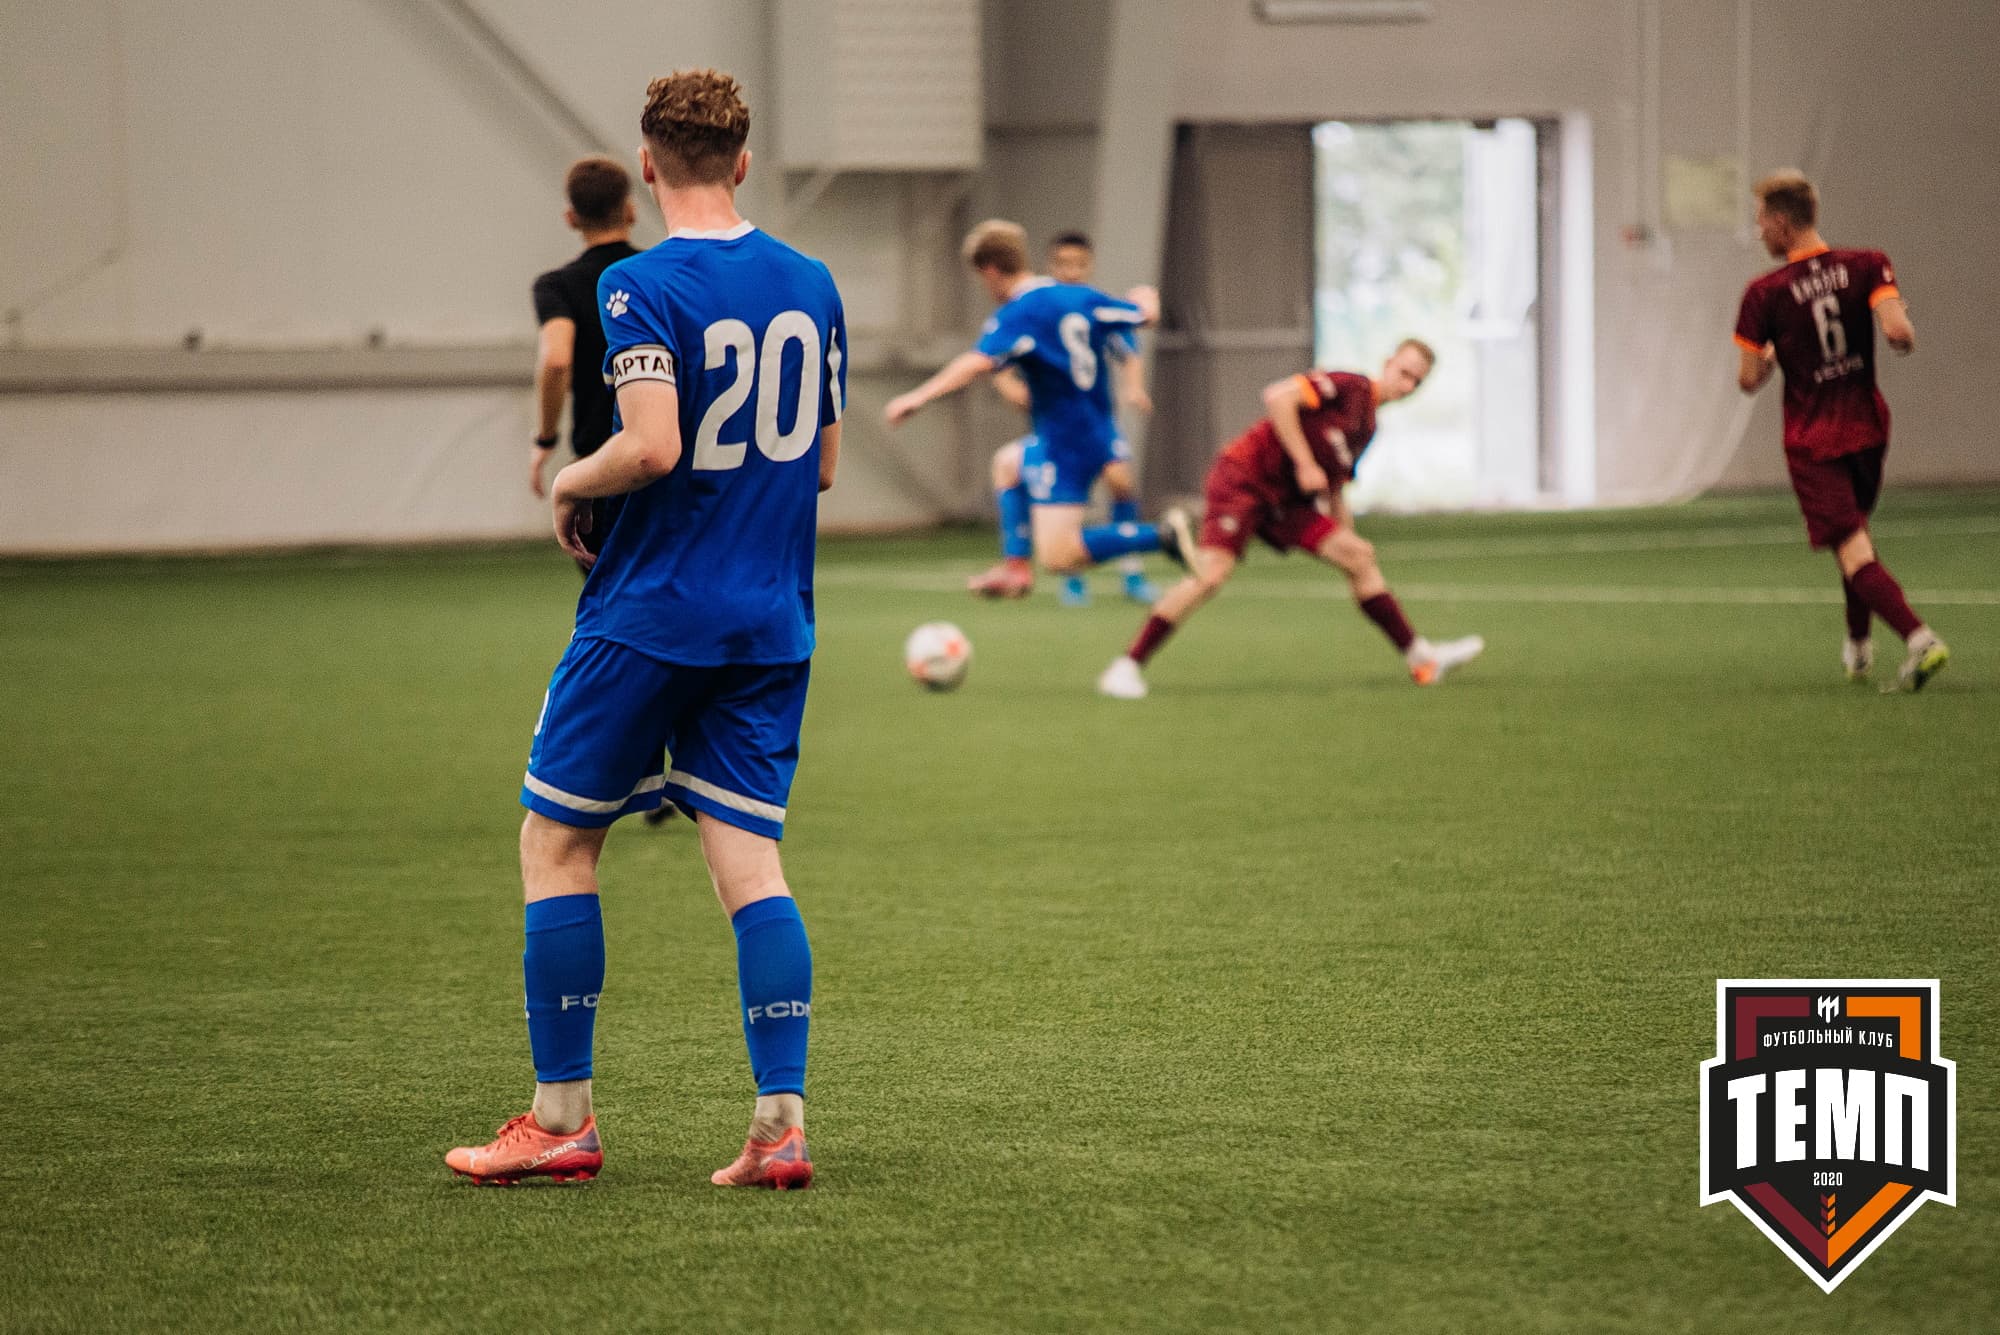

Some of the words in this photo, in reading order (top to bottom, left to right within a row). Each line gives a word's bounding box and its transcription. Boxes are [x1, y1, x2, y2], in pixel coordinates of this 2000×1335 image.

[1811, 294, 1848, 362] 6
[692, 310, 821, 471] 20
[561, 993, 601, 1011] FC
[522, 1141, 577, 1169] ULTRA
